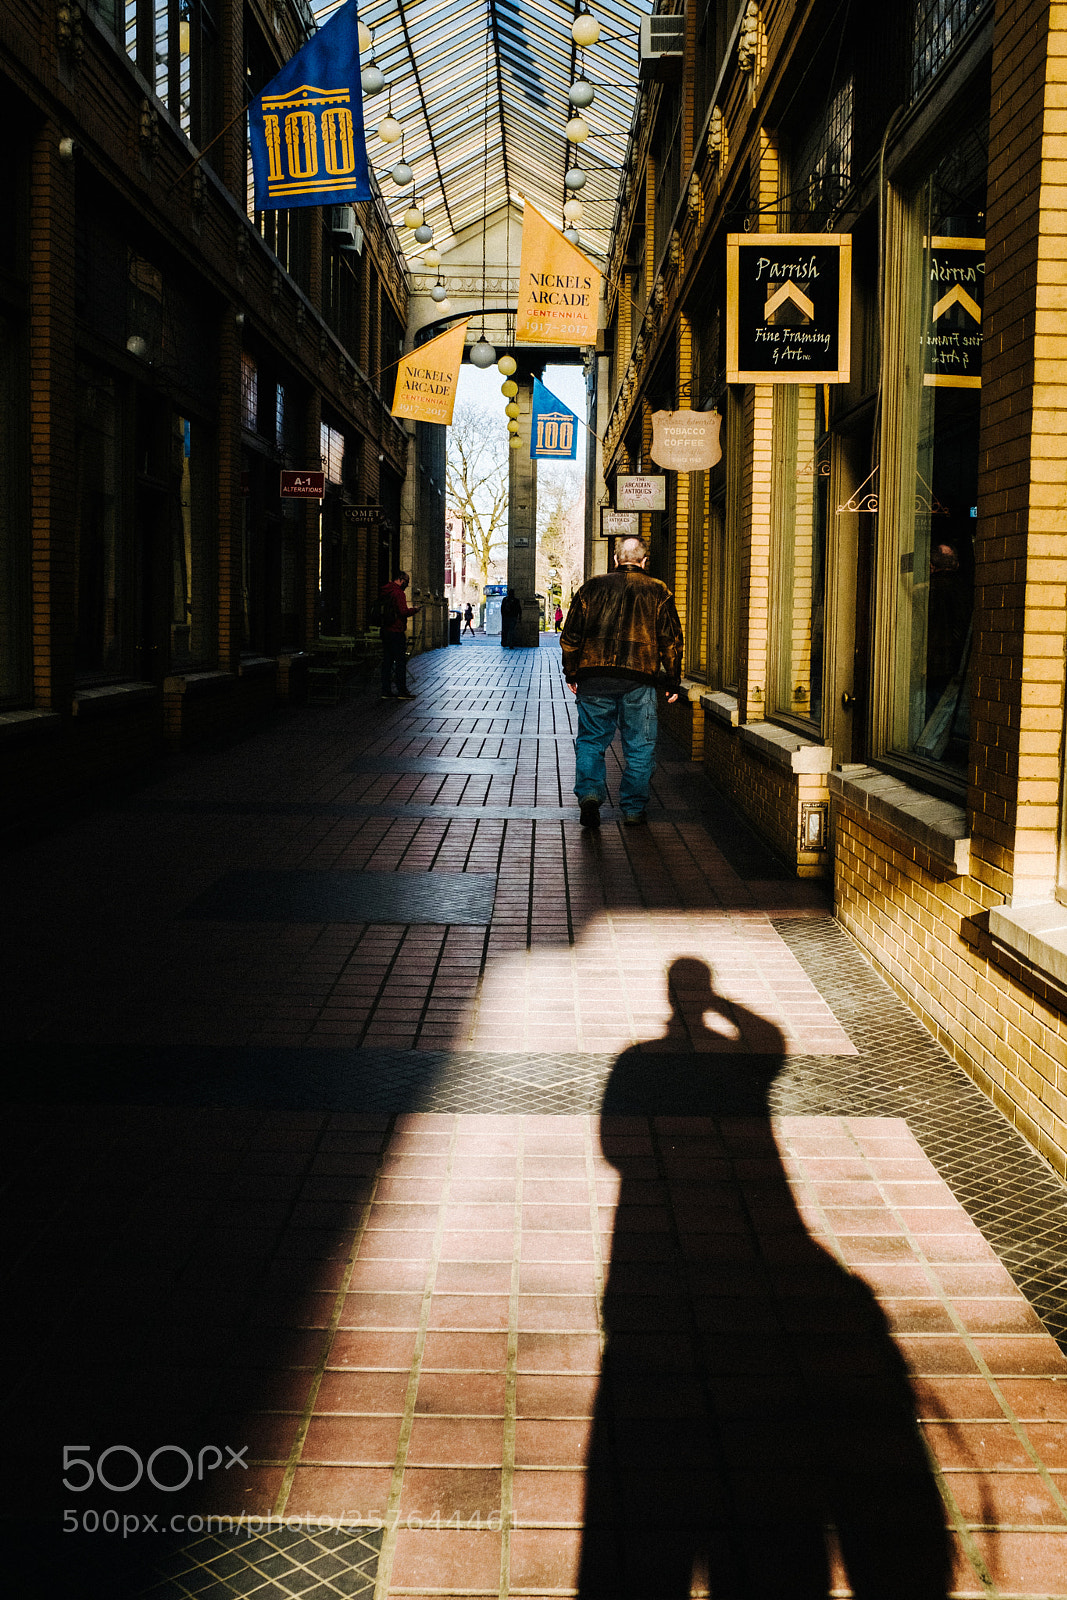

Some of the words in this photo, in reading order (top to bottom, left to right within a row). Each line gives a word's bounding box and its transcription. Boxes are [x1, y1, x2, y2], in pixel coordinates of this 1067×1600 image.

[263, 108, 355, 181] 100
[756, 256, 820, 280] Parrish
[529, 273, 591, 289] NICKELS
[527, 291, 590, 307] ARCADE
[526, 309, 589, 320] CENTENNIAL
[755, 327, 780, 342] Fine
[782, 328, 831, 352] Framing
[781, 345, 803, 360] Art
[404, 366, 453, 383] NICKELS
[402, 380, 450, 396] ARCADE
[401, 393, 449, 406] CENTENNIAL
[535, 421, 573, 449] 100
[664, 427, 706, 435] TOBACCO
[664, 439, 705, 447] COFFEE
[294, 477, 311, 486] A-1
[282, 486, 323, 494] ALTERATIONS
[344, 509, 380, 517] COMET
